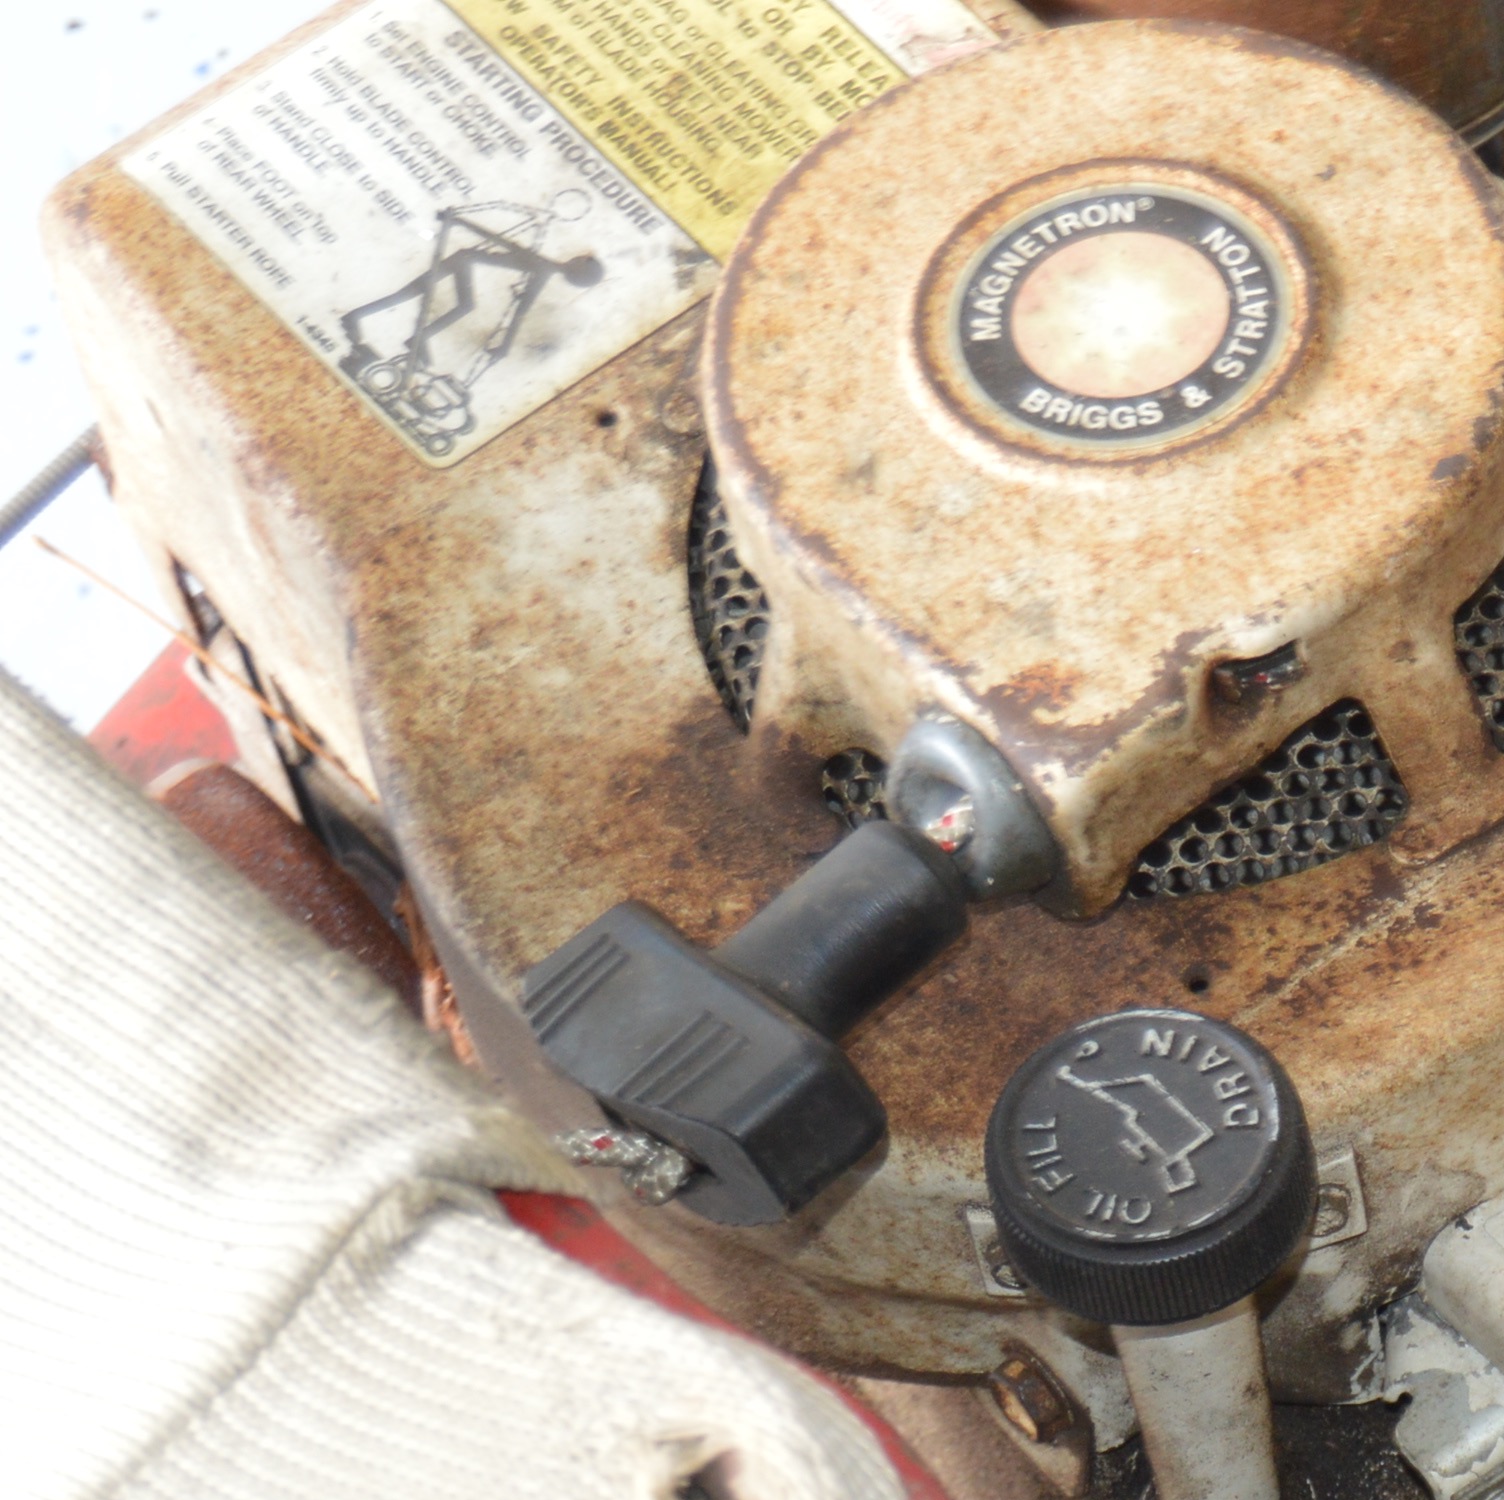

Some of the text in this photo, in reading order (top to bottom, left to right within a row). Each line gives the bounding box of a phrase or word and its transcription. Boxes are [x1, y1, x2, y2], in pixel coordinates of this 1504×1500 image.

[364, 32, 385, 47] to
[379, 46, 431, 91] START
[424, 90, 443, 105] or
[568, 10, 594, 30] of
[587, 29, 648, 82] BLADE
[591, 0, 658, 57] HANDS
[649, 57, 672, 75] or
[711, 113, 765, 159] NEAR
[631, 7, 803, 161] or CLEANING MOWER
[684, 25, 706, 42] or
[704, 40, 793, 119] CLEARING
[761, 40, 815, 87] STOP
[762, 7, 796, 36] OR
[801, 44, 834, 70] BY
[252, 103, 273, 119] of
[271, 90, 315, 128] Stand
[308, 126, 363, 174] CLOSE
[358, 174, 379, 191] to
[372, 189, 414, 224] SIDE
[304, 68, 350, 107] firmly
[341, 105, 367, 125] up
[365, 122, 387, 139] to
[326, 55, 364, 86] Hold
[356, 84, 412, 132] BLADE
[403, 130, 481, 198] CONTROL
[403, 42, 463, 95] ENGINE
[458, 94, 533, 160] CONTROL
[441, 30, 664, 235] STARTING PROCEDURE
[496, 23, 678, 192] OPERATOR'S MANUAL!
[530, 22, 605, 88] SAFETY
[604, 94, 741, 217] INSTRUCTIONS
[196, 138, 216, 153] of
[210, 152, 256, 191] REAR
[216, 126, 257, 161] Place
[252, 160, 299, 200] FOOT
[291, 201, 314, 220] on
[307, 218, 341, 246] top
[160, 162, 190, 187] Pull
[183, 185, 256, 249] STARTER
[247, 248, 295, 289] ROPE
[1019, 225, 1270, 431] BRIGGS & STRATTON
[1140, 1027, 1260, 1130] DRAIN
[1022, 1114, 1153, 1225] OIL FILL
